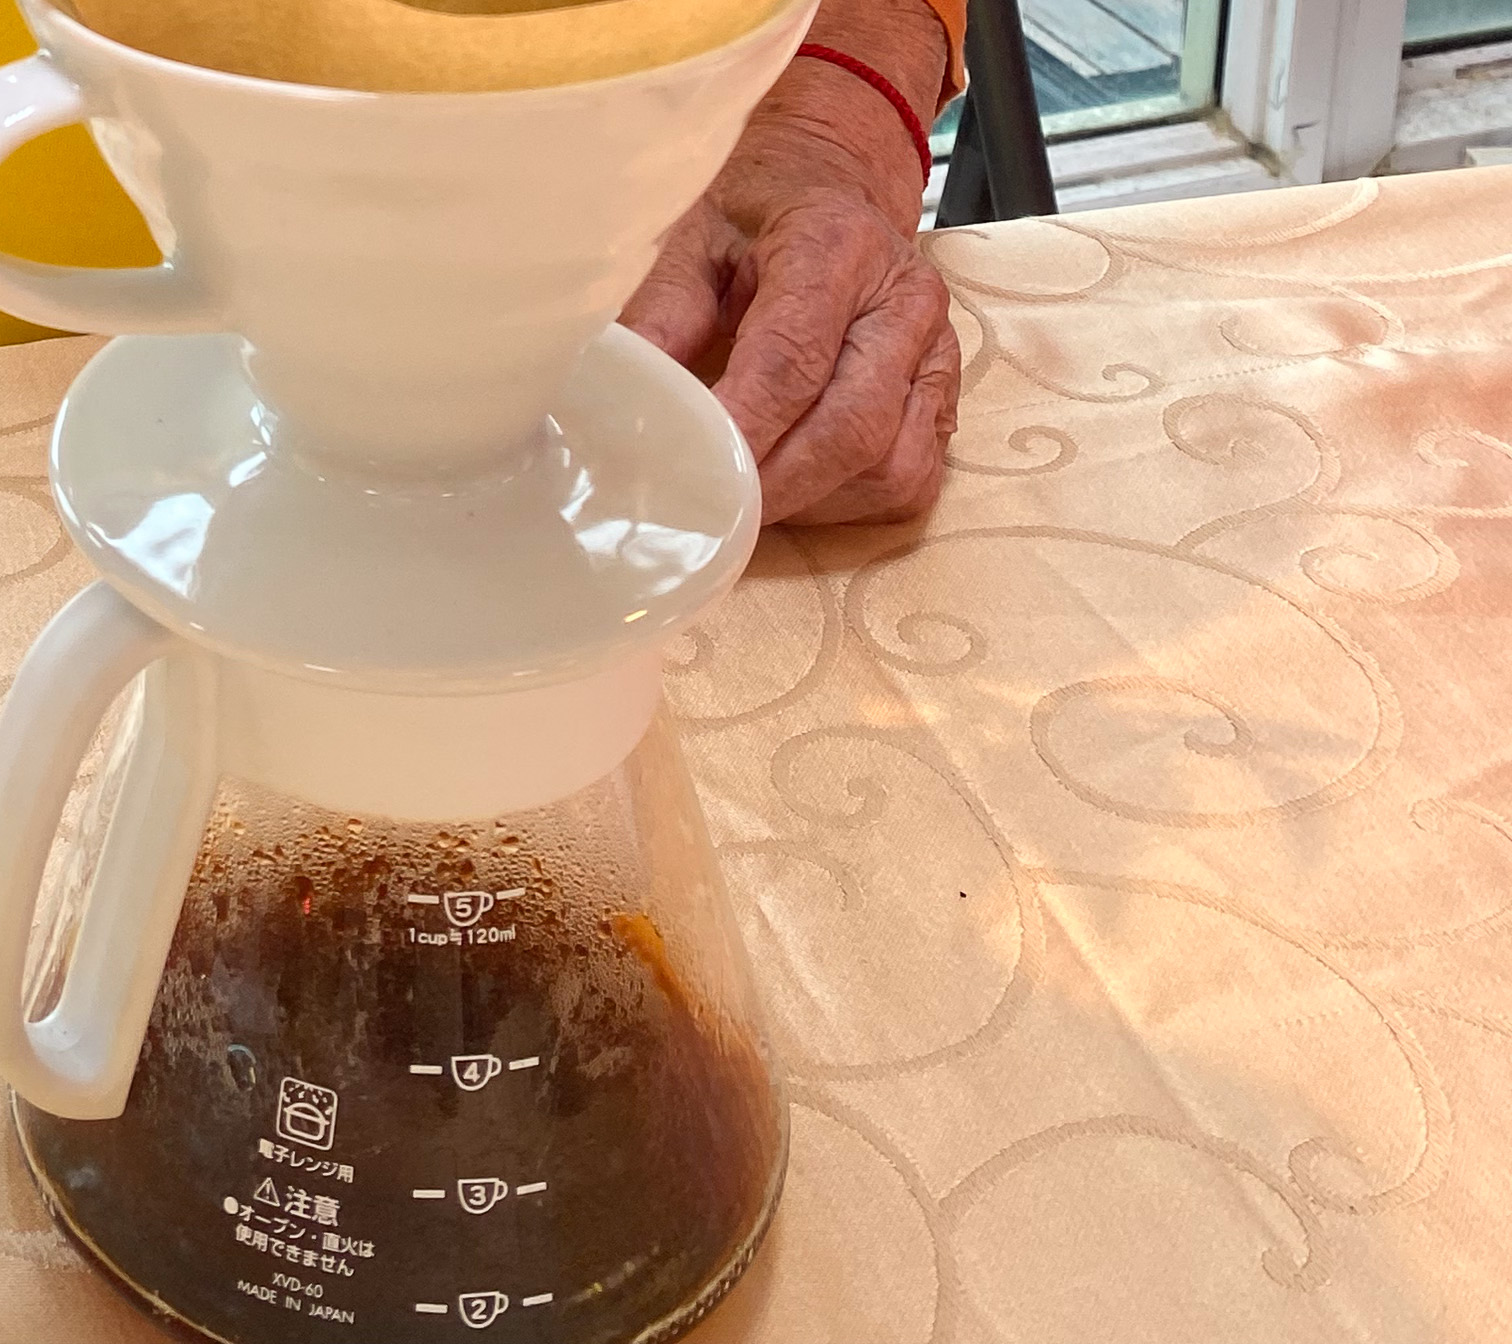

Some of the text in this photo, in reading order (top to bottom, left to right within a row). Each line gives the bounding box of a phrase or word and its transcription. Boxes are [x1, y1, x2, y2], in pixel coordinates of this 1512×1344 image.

[455, 897, 473, 918] 5
[462, 1061, 481, 1083] 4
[258, 1138, 355, 1183] 電子レンジ用
[284, 1185, 340, 1227] 注意
[469, 1185, 487, 1206] 3
[235, 1223, 355, 1277] 使用できません
[272, 1272, 324, 1298] XVD-60
[237, 1279, 355, 1324] MADE IN JAPAN
[471, 1298, 488, 1320] 2
